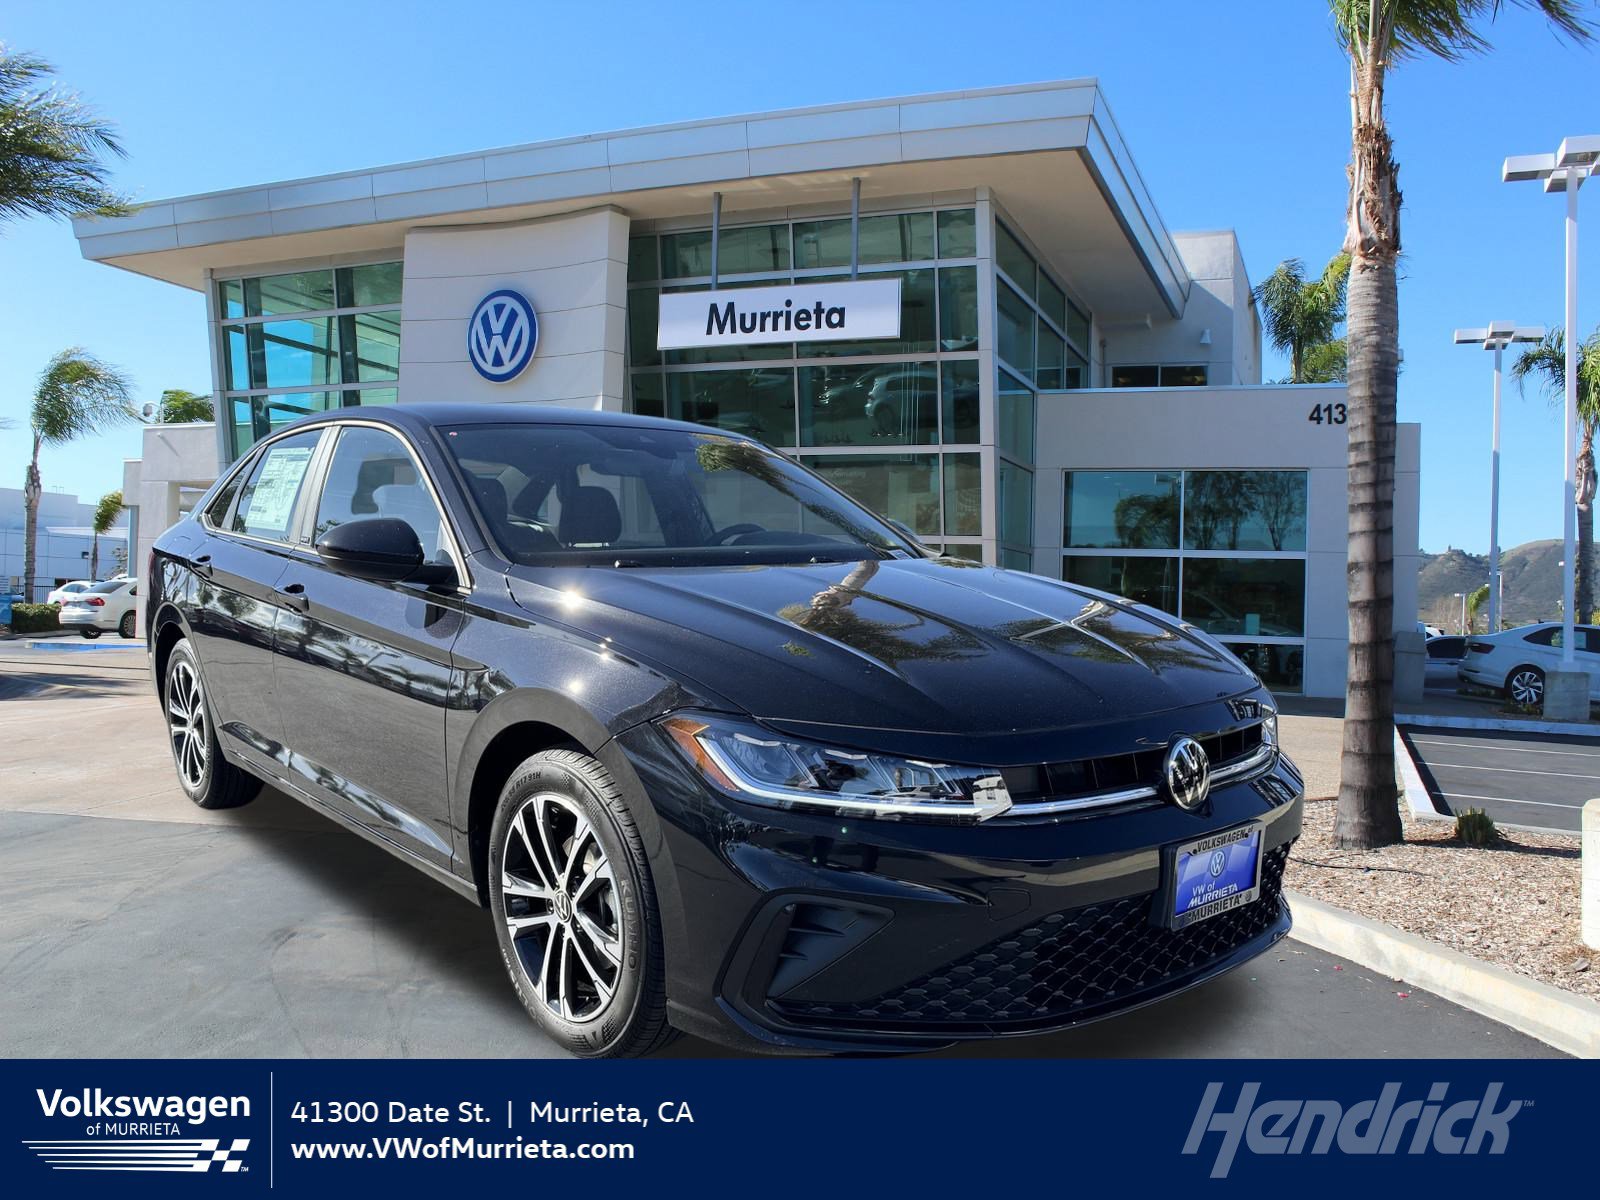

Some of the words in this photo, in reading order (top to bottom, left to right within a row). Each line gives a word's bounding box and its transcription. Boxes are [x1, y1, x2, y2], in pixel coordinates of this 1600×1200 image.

[705, 298, 847, 337] Murrieta
[1196, 830, 1247, 853] VOLKSWAGEN
[1188, 883, 1239, 909] MURRIETA
[1192, 884, 1206, 896] VW
[1207, 880, 1216, 892] of
[1190, 894, 1241, 922] MURRIETA
